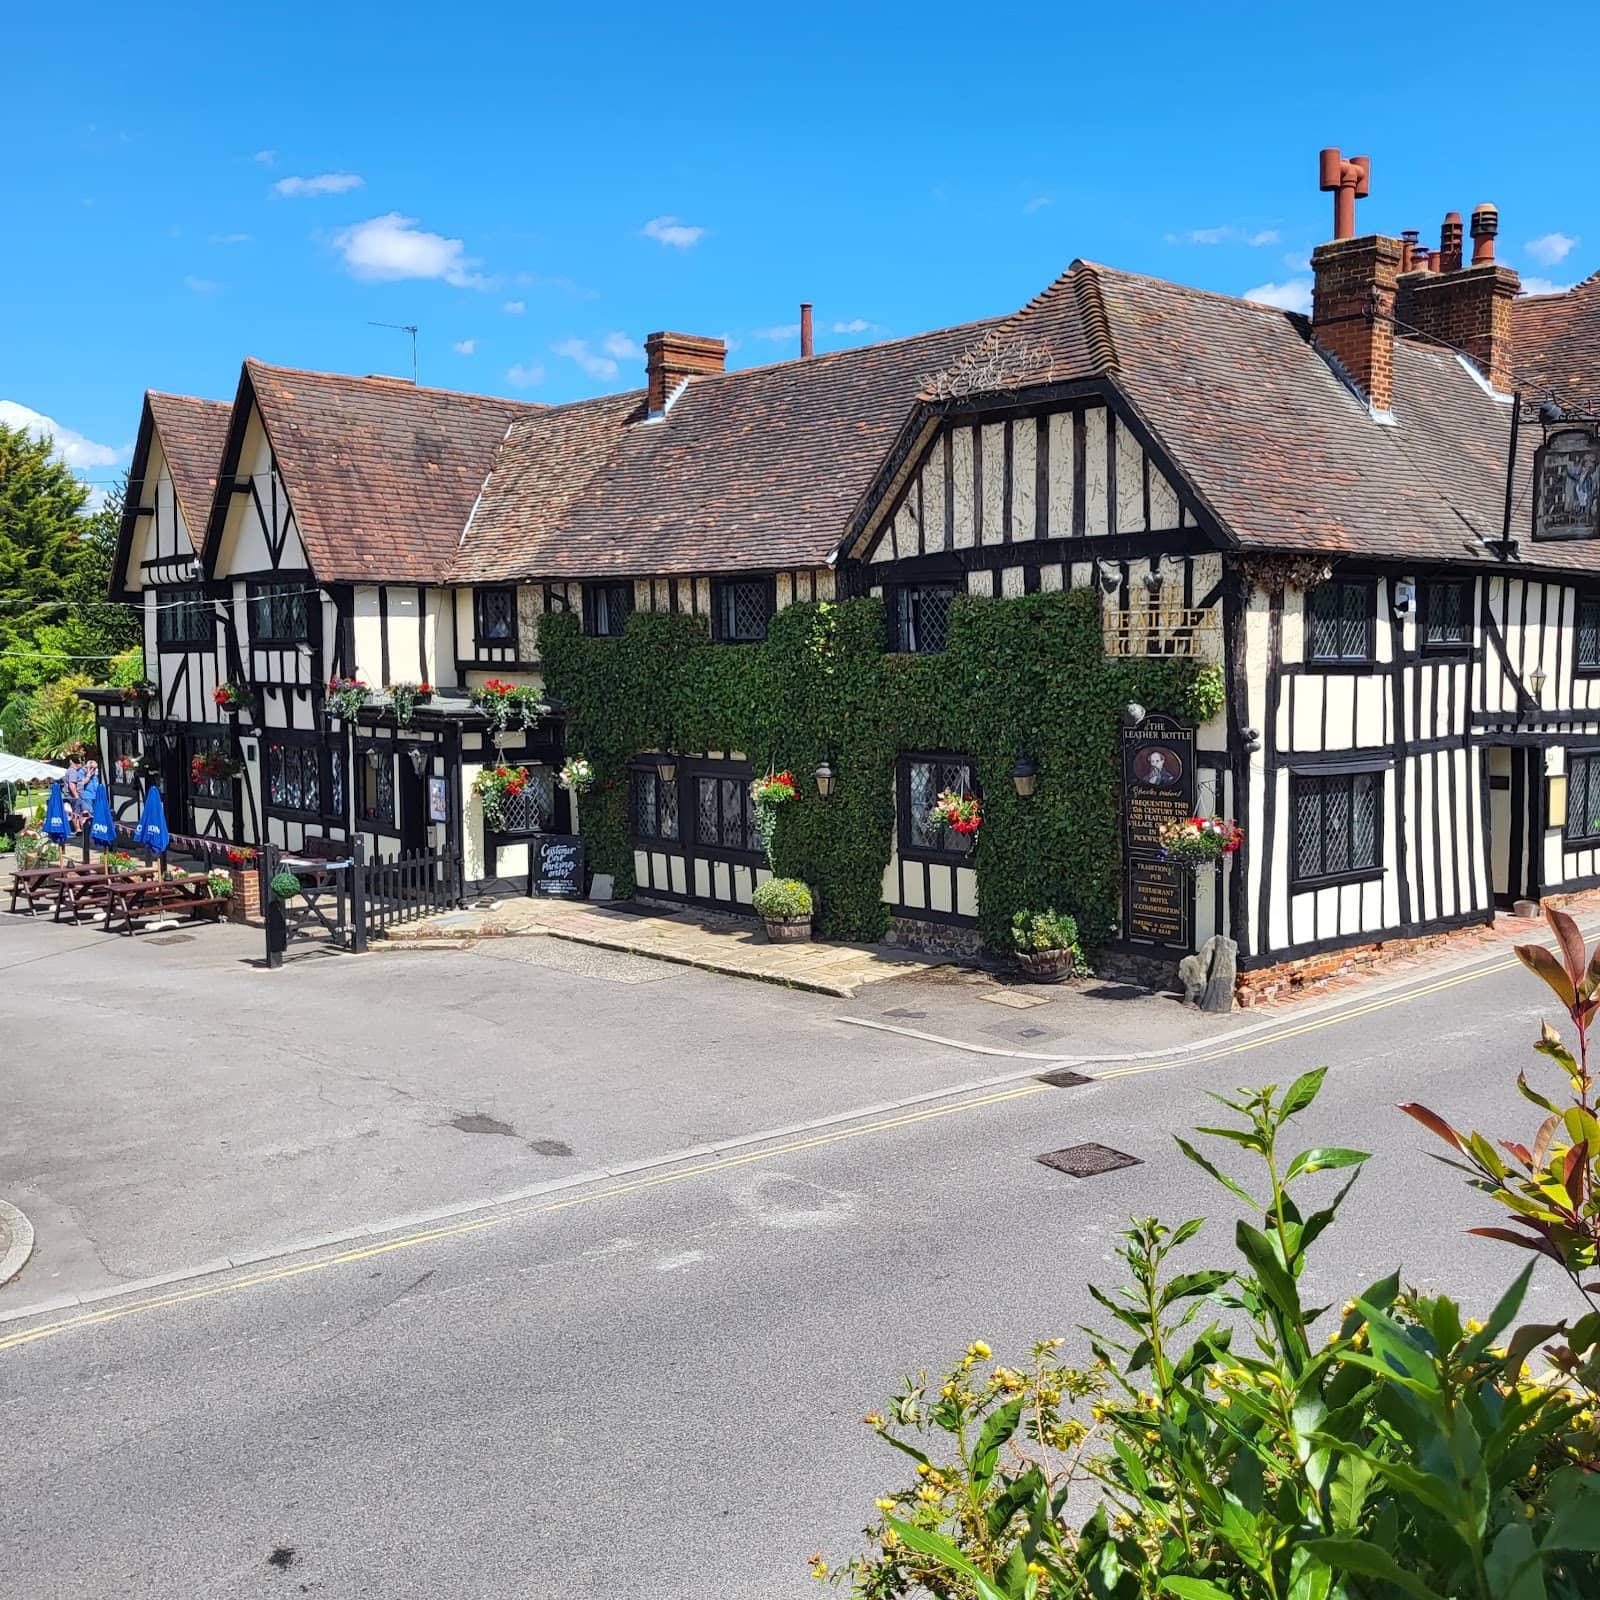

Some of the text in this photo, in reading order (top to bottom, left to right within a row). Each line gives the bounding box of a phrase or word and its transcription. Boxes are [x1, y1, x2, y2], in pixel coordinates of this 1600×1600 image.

[1103, 608, 1217, 631] LEATHER
[1105, 635, 1202, 657] BOTTLE
[1150, 722, 1165, 731] THE
[1124, 730, 1192, 740] LEATHER BOTTLE
[1131, 799, 1172, 808] FREQUENTED
[1144, 807, 1174, 815] CENTURY
[1144, 814, 1177, 823] FEATURED
[1128, 820, 1153, 828] VILLAGE
[540, 844, 576, 856] Customer
[547, 854, 566, 864] Car
[542, 861, 576, 872] Parking
[548, 868, 570, 879] only
[1150, 896, 1168, 904] HOTEL
